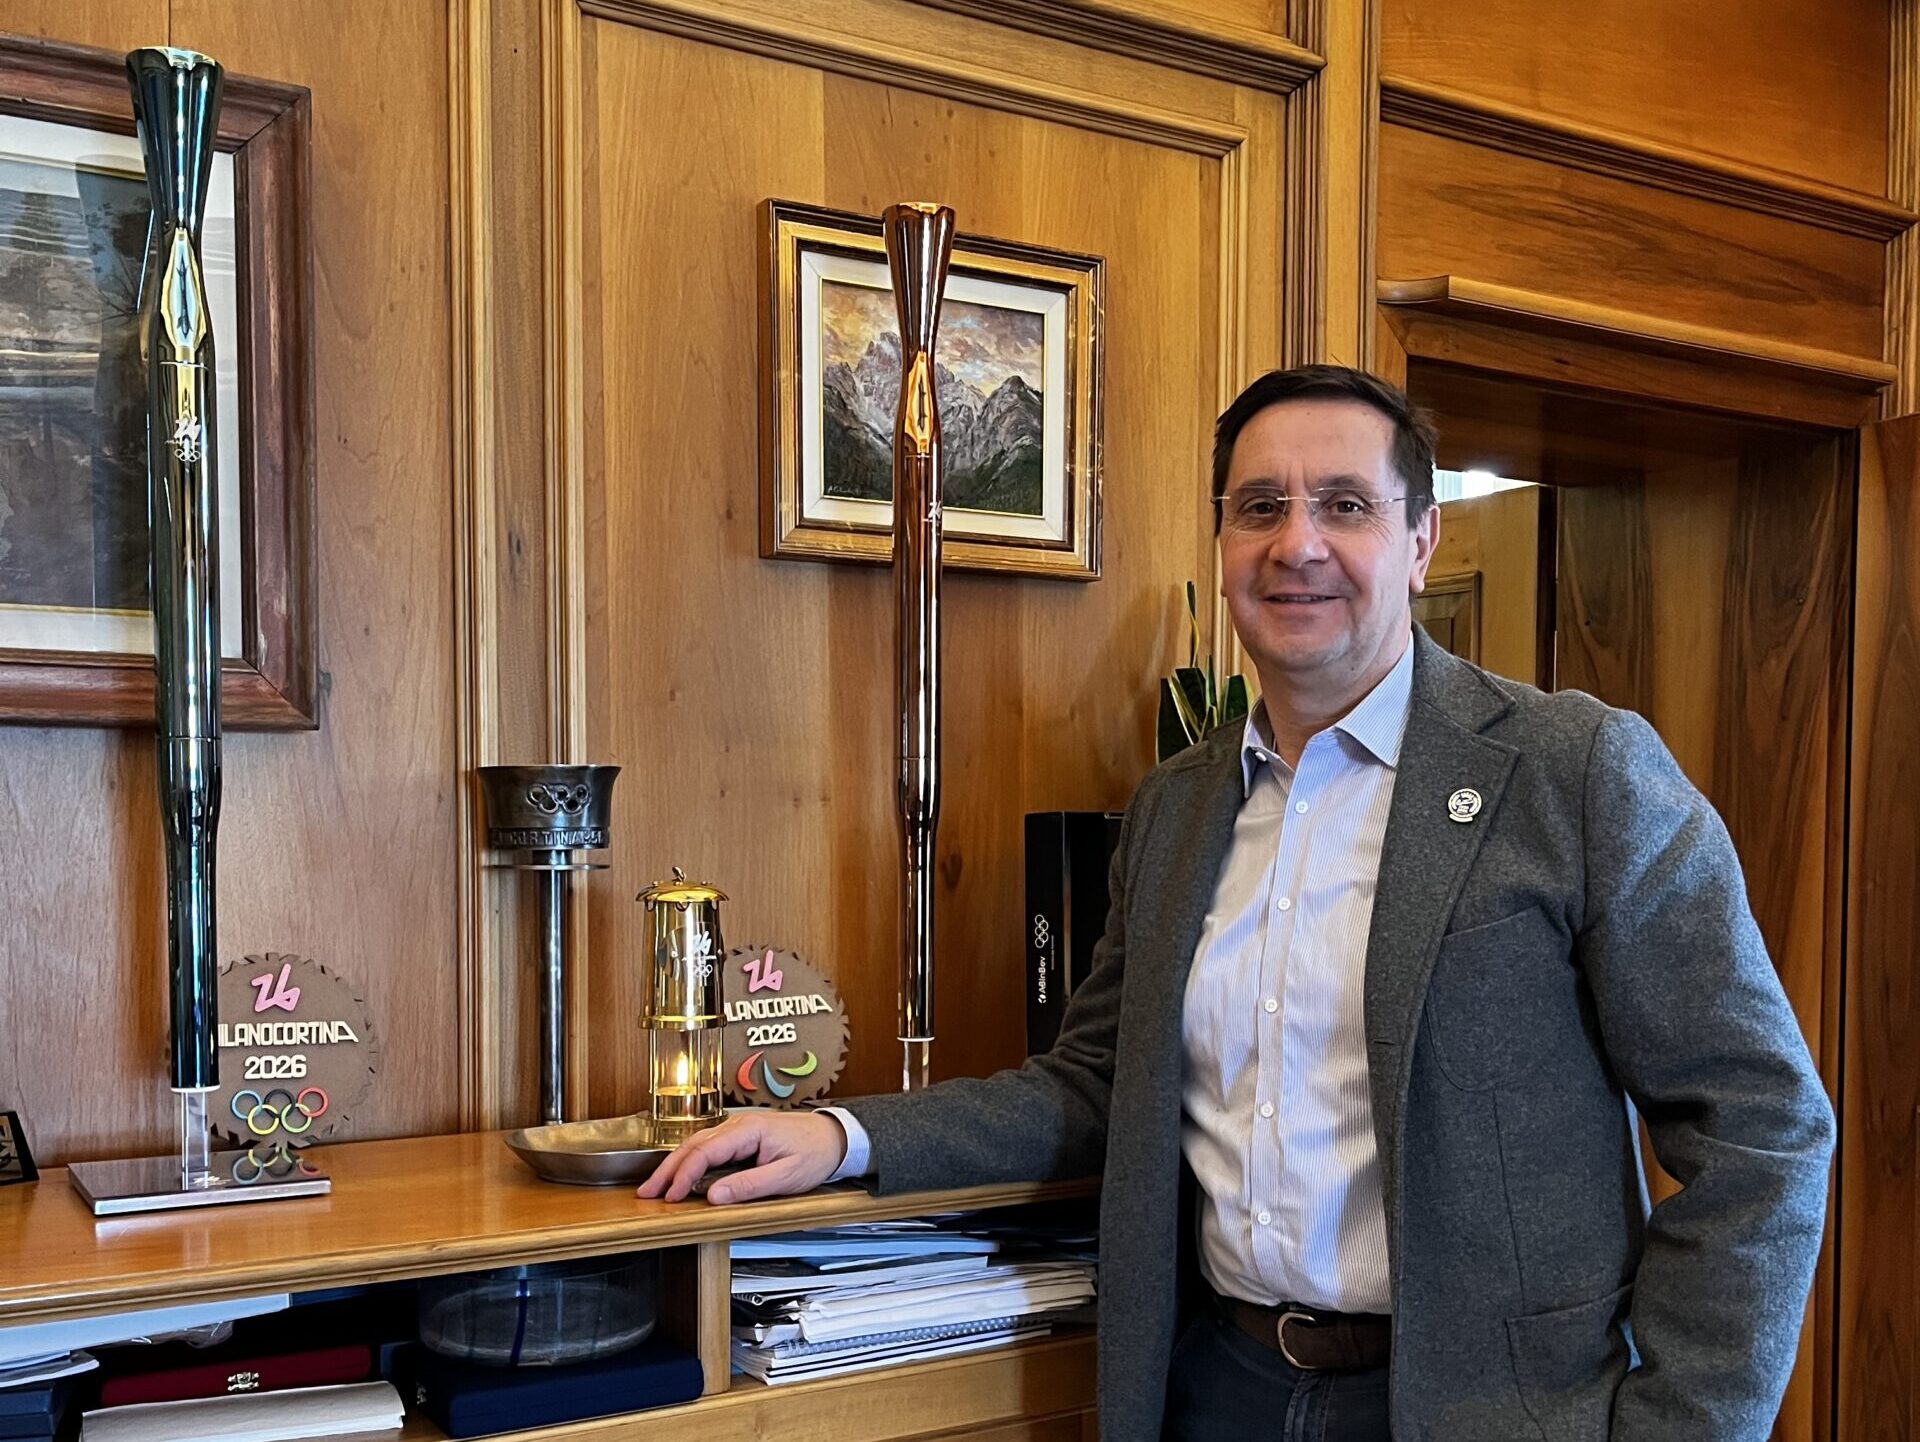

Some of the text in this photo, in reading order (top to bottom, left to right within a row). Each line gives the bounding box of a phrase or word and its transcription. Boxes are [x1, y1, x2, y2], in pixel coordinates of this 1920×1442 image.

[724, 994, 833, 1022] ILANOCORTINA
[218, 1020, 360, 1047] ILANOCORTINA
[746, 1022, 797, 1047] 2026
[244, 1054, 307, 1080] 2026
